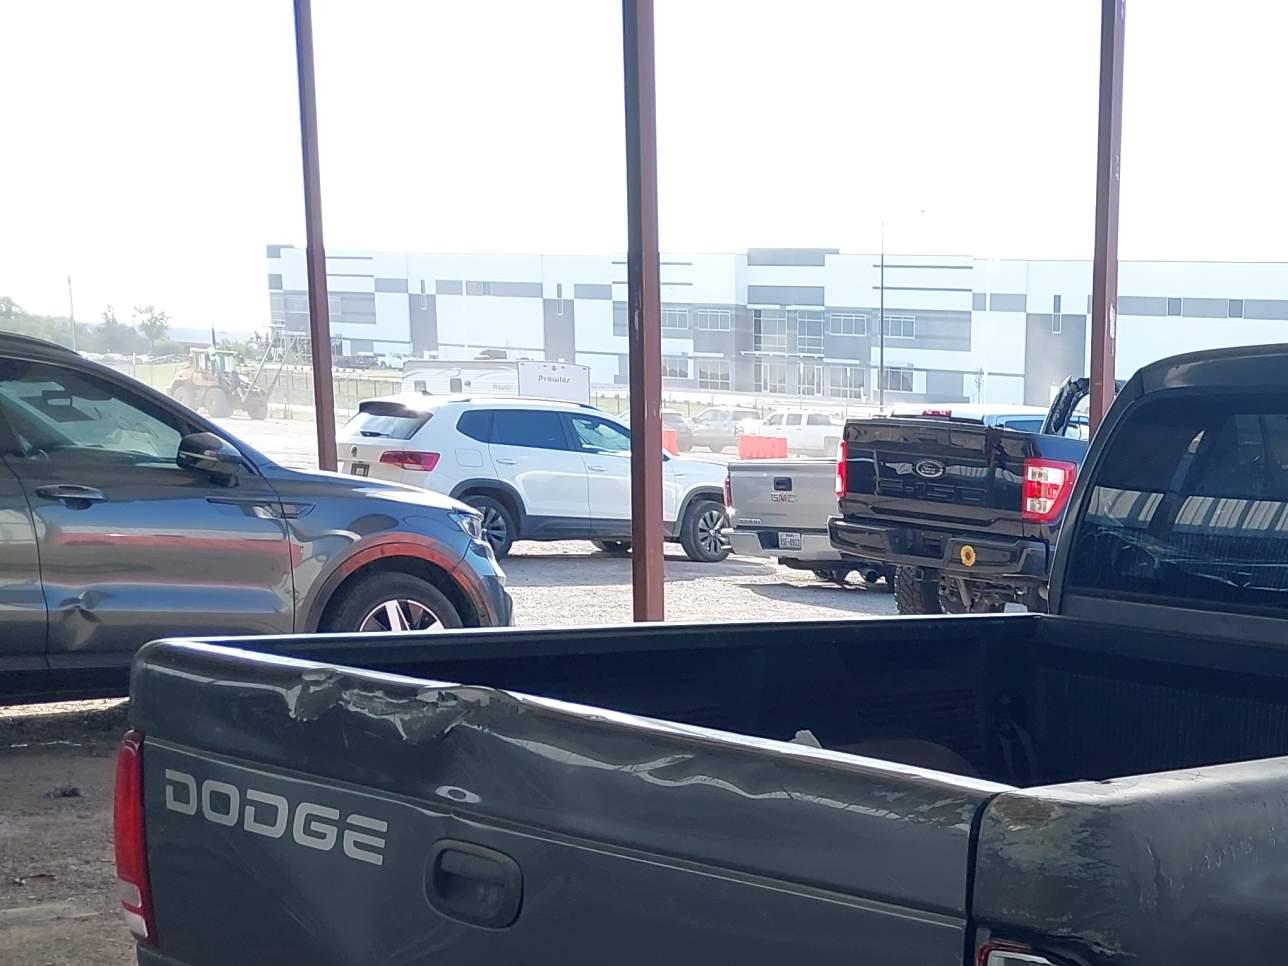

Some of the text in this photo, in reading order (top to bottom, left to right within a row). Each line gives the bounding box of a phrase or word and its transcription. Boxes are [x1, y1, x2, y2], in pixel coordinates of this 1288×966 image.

[538, 374, 570, 384] Prowler
[770, 493, 798, 503] GMC
[165, 768, 388, 866] DODGE
